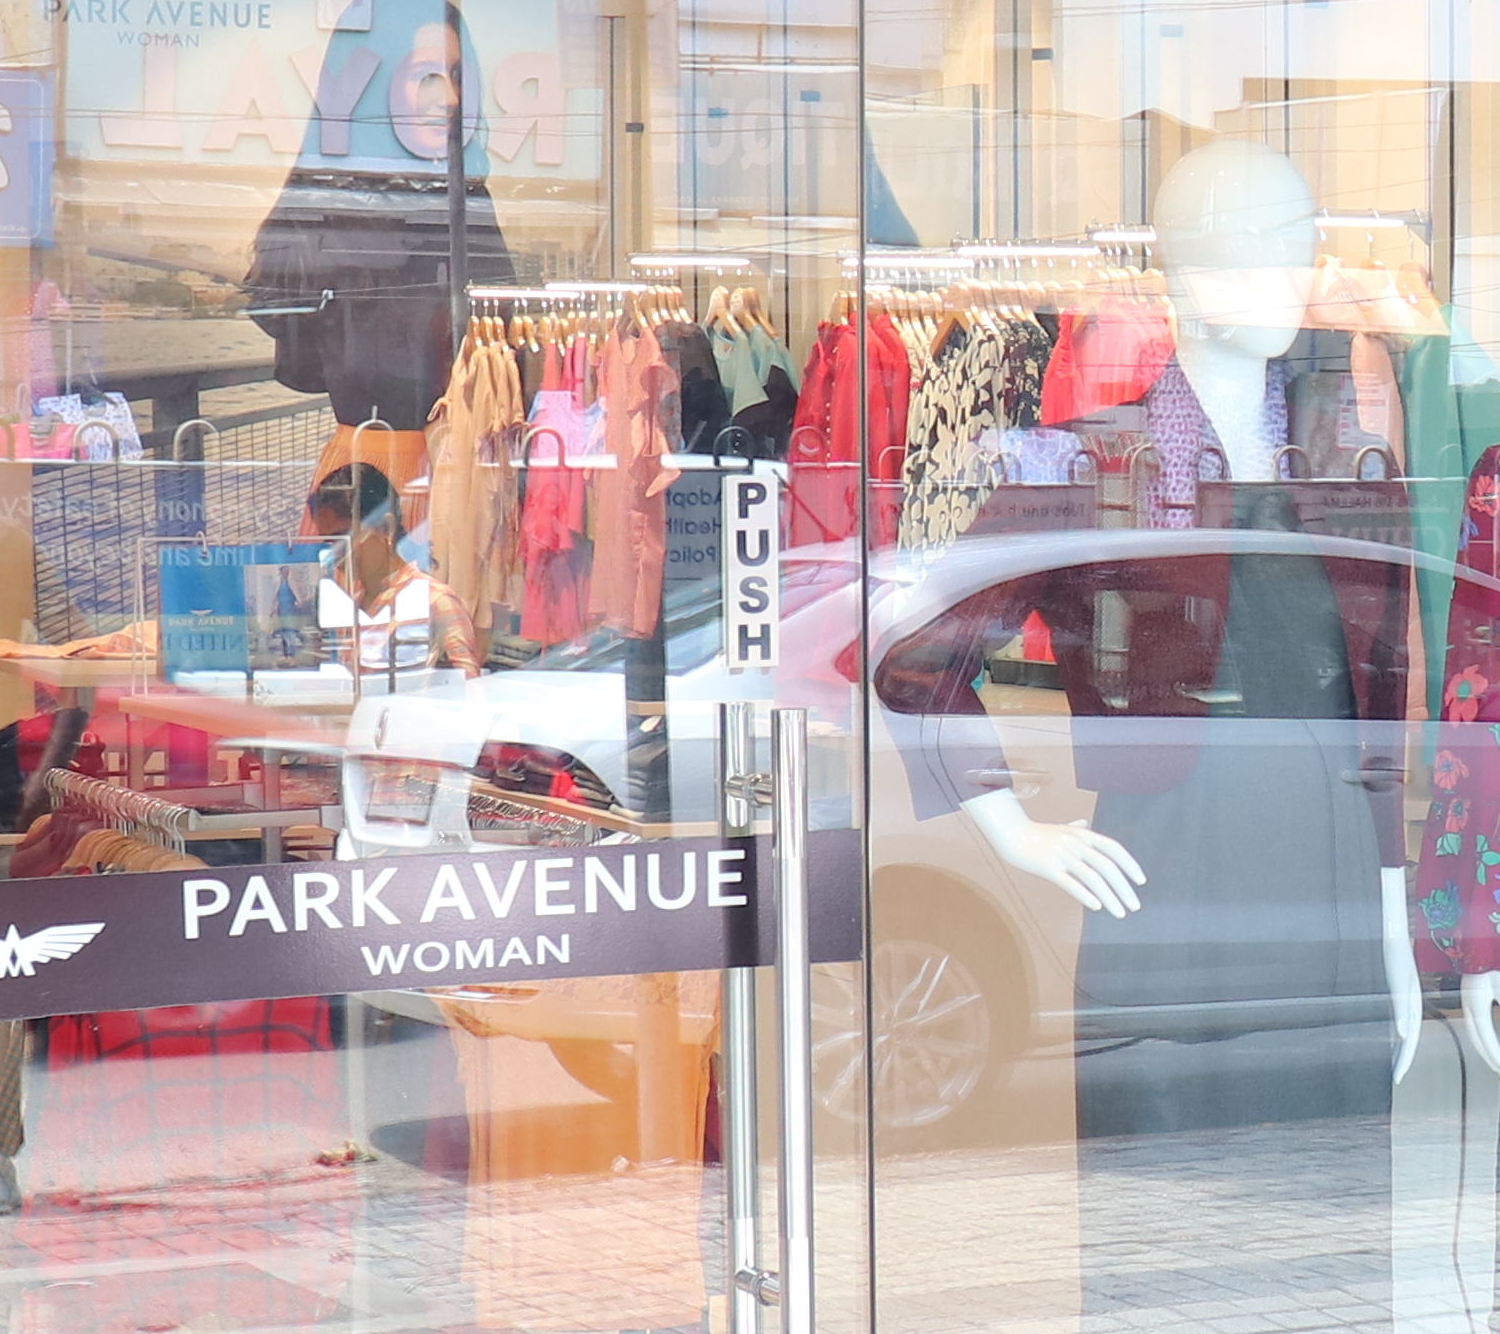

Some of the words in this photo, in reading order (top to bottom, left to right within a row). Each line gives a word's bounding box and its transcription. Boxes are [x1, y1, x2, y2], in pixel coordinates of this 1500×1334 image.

[116, 31, 200, 48] WOMAN
[736, 481, 773, 663] PUSH
[181, 865, 400, 941] PARK
[420, 849, 748, 924] AVENUE
[361, 933, 570, 978] WOMAN
